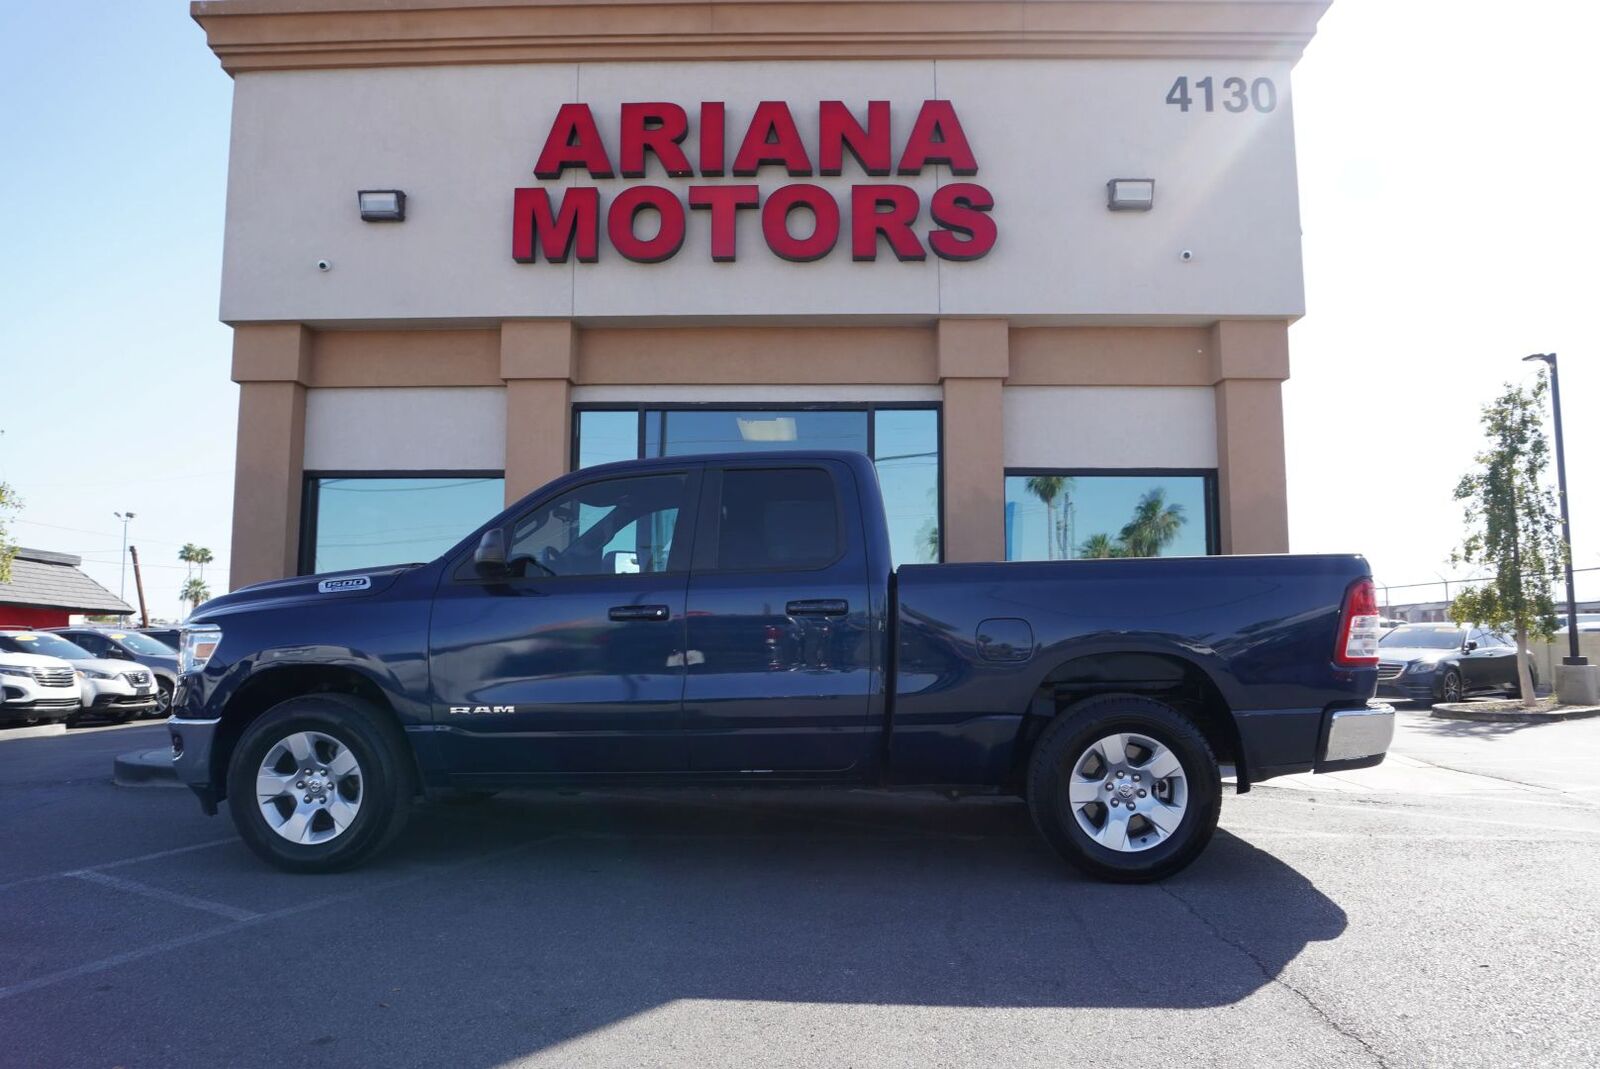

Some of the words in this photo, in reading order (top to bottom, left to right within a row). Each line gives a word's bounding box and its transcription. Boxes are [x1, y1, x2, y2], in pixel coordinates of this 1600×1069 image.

[1165, 76, 1277, 113] 4130
[533, 99, 979, 179] ARIANA
[512, 183, 998, 263] MOTORS
[325, 578, 367, 589] 1500
[449, 706, 516, 715] RAM
